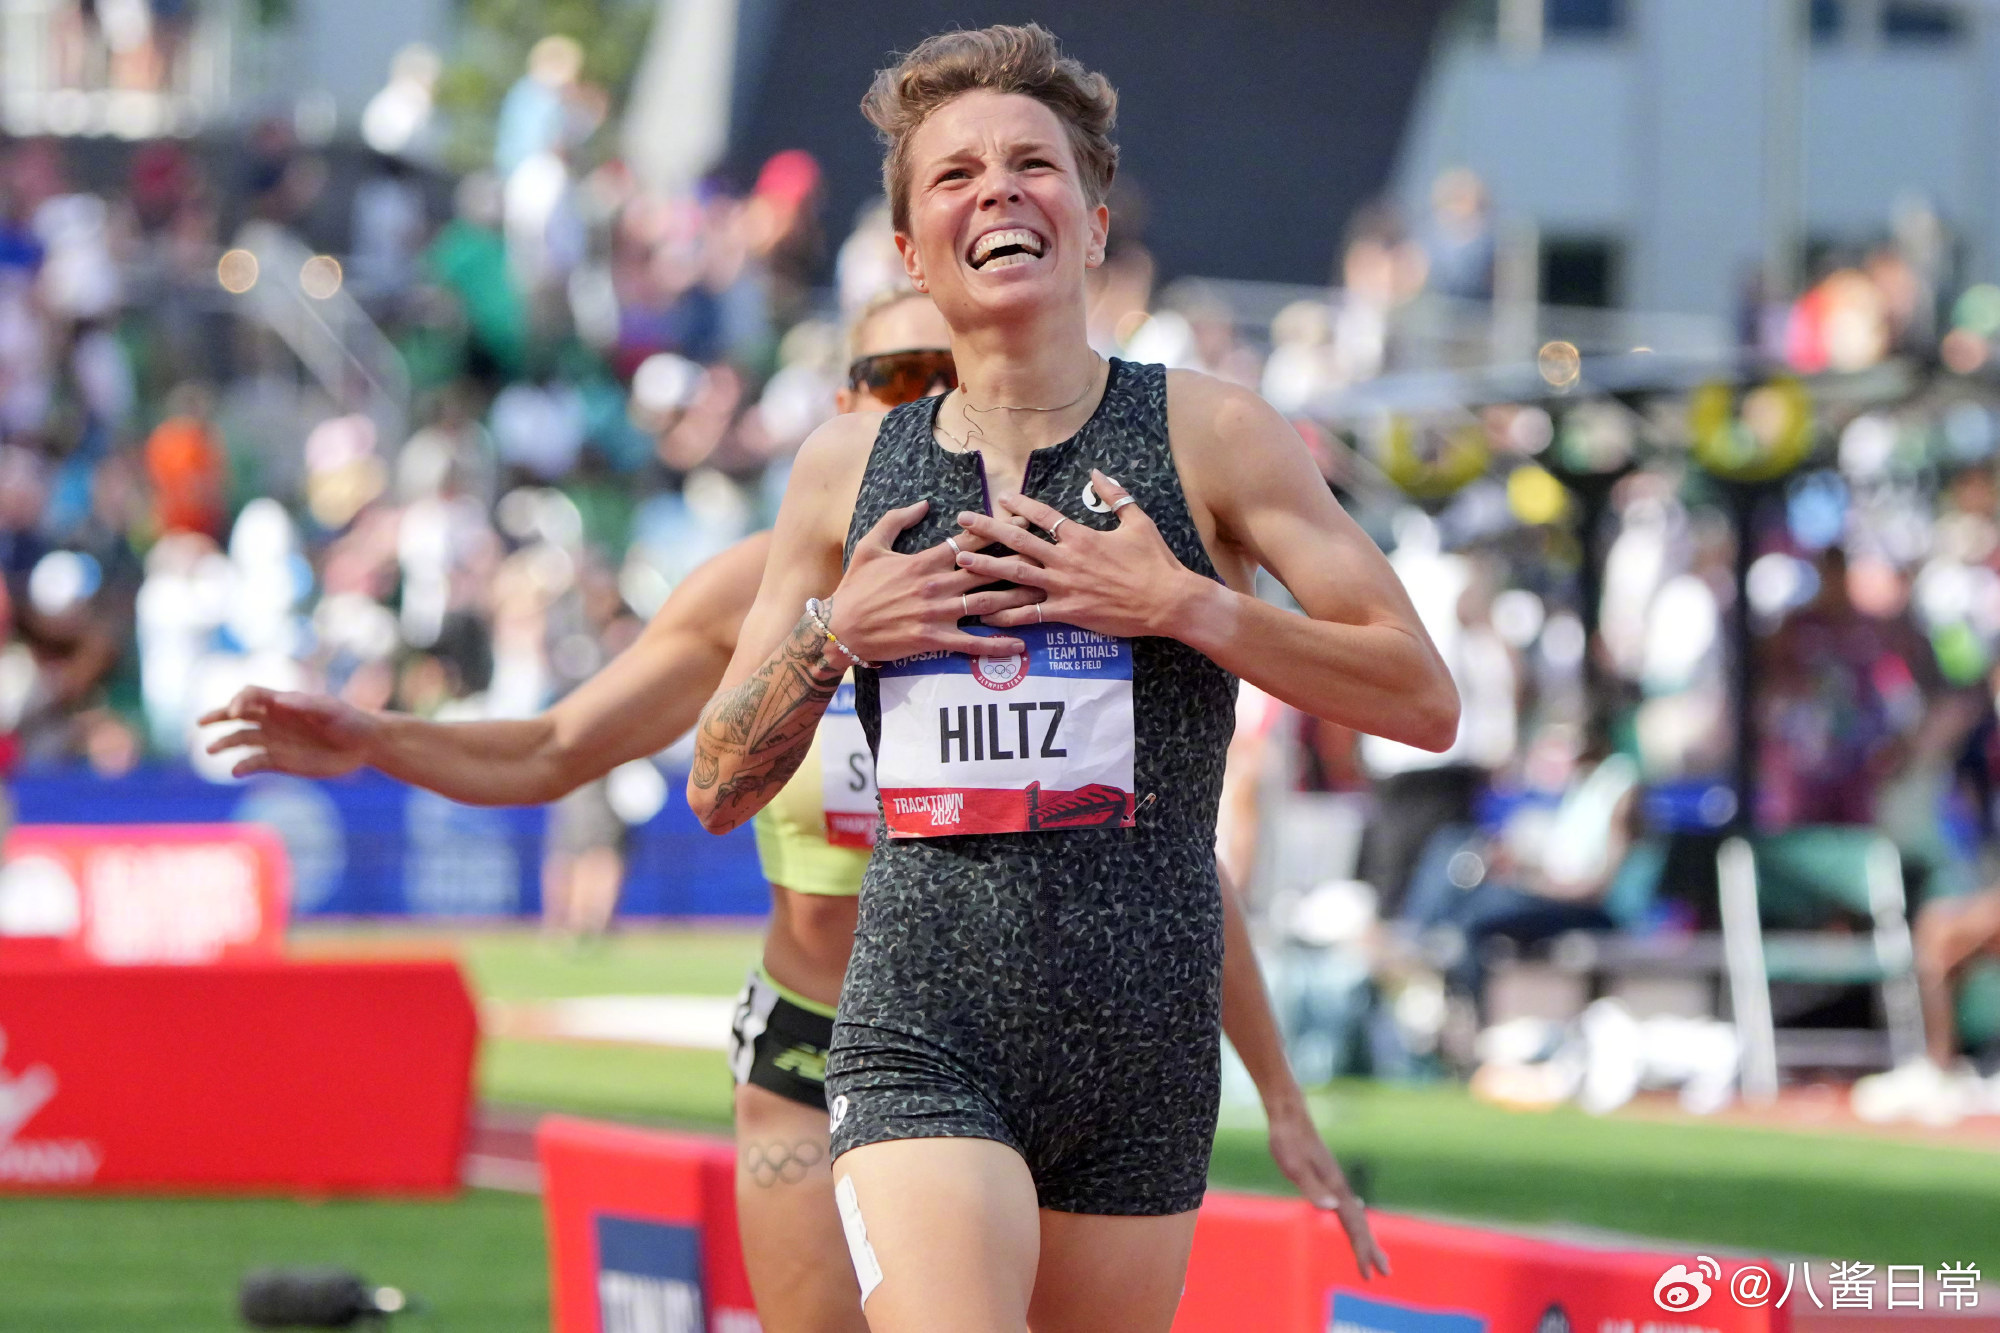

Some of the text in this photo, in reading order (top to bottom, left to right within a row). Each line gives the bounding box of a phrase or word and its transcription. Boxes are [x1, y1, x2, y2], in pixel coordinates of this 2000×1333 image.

[1046, 631, 1118, 645] U.S. OLYMPIC
[1047, 644, 1119, 660] TEAM TRIALS
[1049, 660, 1102, 671] TRACK & FIELD
[1006, 674, 1022, 688] TEAM
[939, 701, 1067, 764] HILTZ
[893, 793, 964, 815] TRACKTOWN
[931, 808, 961, 826] 2024
